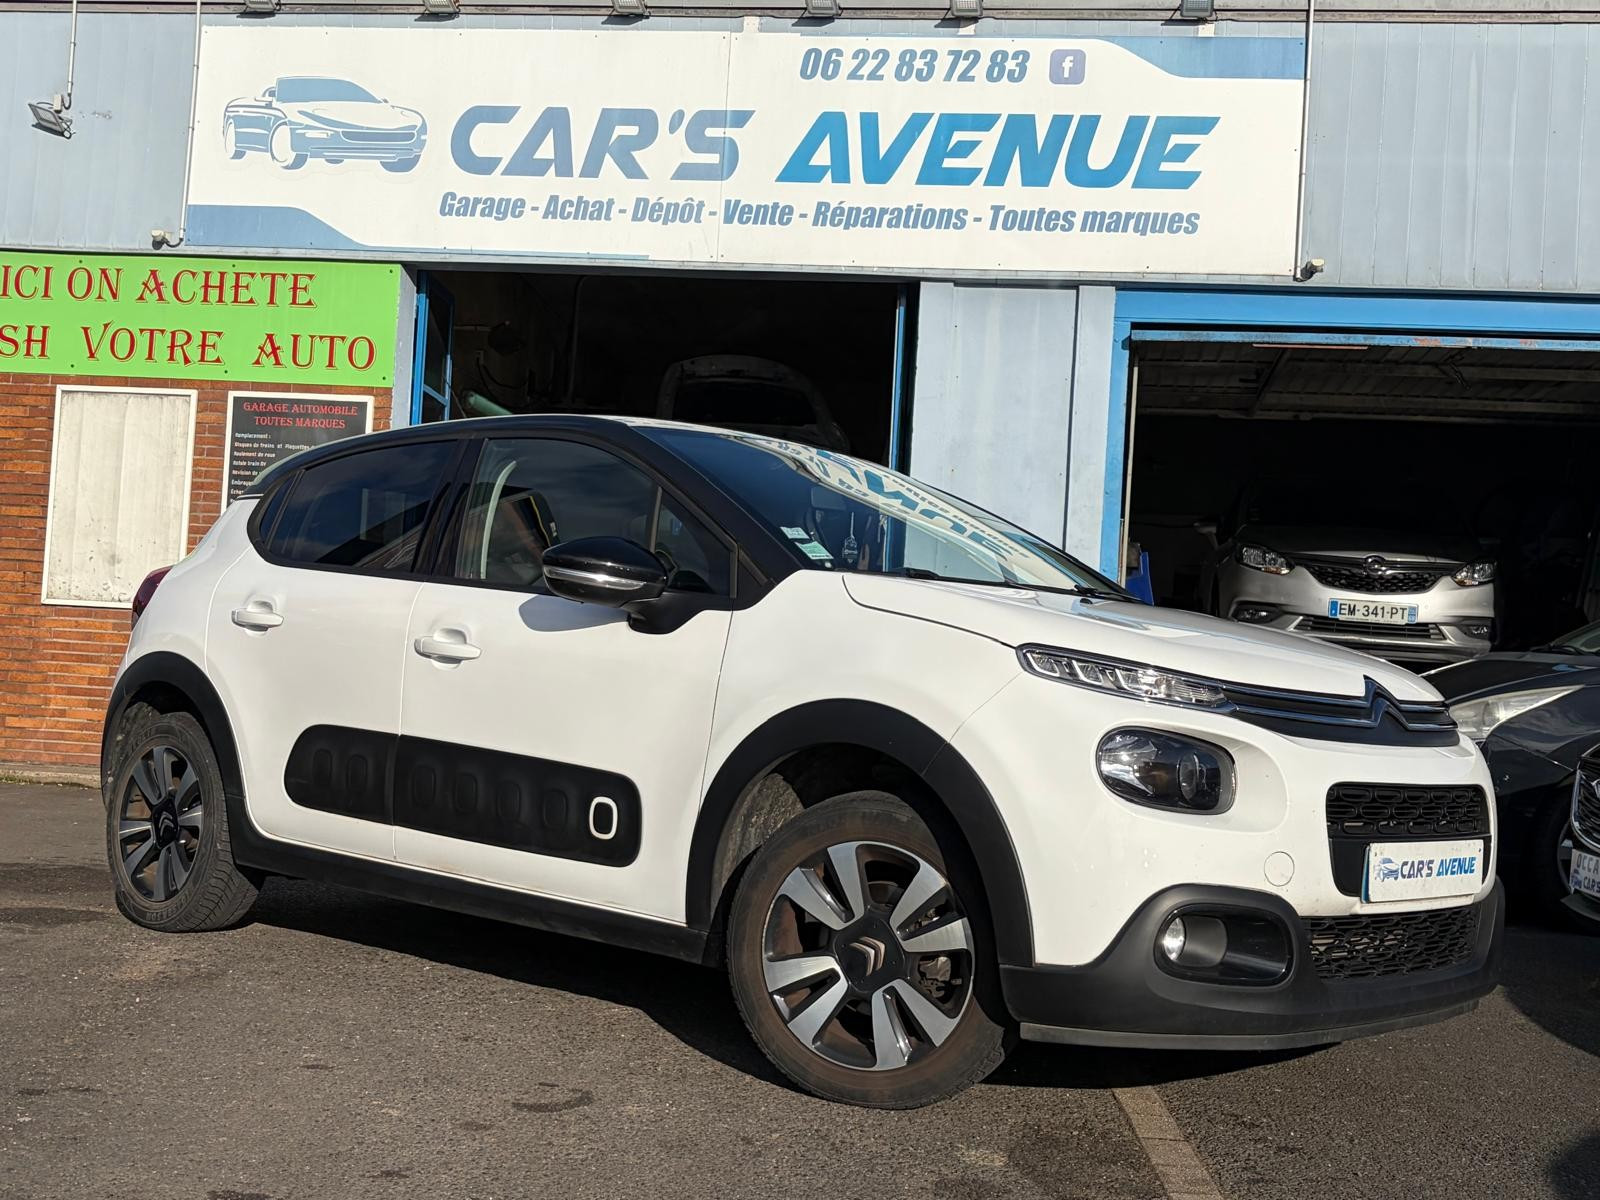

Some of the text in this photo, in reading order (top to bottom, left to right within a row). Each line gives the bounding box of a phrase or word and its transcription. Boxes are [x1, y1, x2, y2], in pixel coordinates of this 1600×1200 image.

[799, 47, 844, 80] 06
[846, 49, 890, 81] 22
[894, 49, 938, 82] 83
[939, 50, 981, 82] 72
[985, 50, 1030, 83] 83
[450, 105, 1221, 189] CAR'S AVENUE
[439, 191, 526, 221] Garage
[542, 195, 615, 222] Achat
[631, 197, 706, 225] Dépôt
[722, 200, 795, 226] Vente
[812, 200, 969, 231] Réparations
[988, 205, 1077, 232] Toutes
[1081, 209, 1201, 236] marques
[0, 265, 319, 309] ICI ON ACHETE
[81, 320, 226, 367] VOTRE
[251, 332, 376, 371] AUTO
[243, 402, 359, 416] GARAGE AUTOMOBILE
[254, 416, 346, 429] TOUTES MARQUES
[1339, 602, 1408, 620] EM-341-PT
[1400, 856, 1477, 879] CAR'S AVENUE
